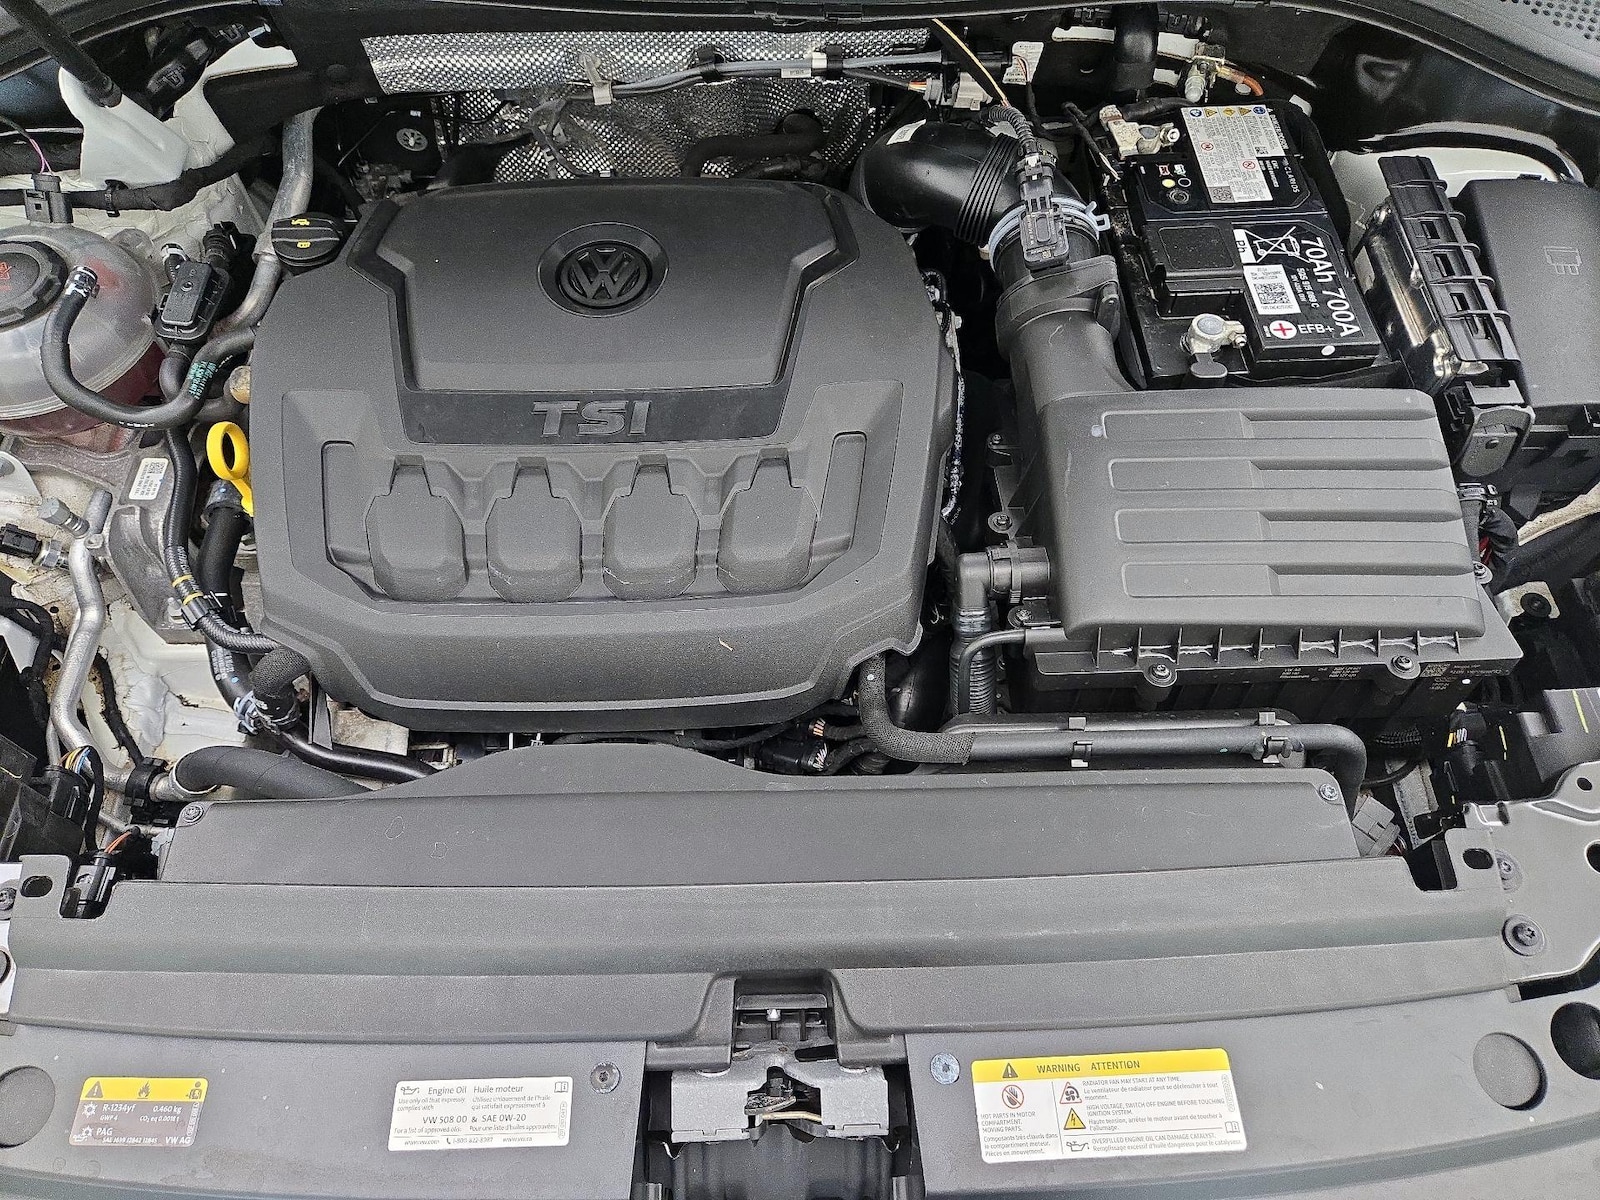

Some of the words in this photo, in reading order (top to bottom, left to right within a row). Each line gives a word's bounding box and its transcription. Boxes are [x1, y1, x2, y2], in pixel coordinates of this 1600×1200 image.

[1301, 236, 1336, 282] 70Ah
[1322, 288, 1360, 337] 700A
[530, 400, 652, 438] TSI
[1036, 1063, 1081, 1073] WARNING
[1091, 1060, 1140, 1070] ATTENTION
[428, 1086, 454, 1096] Engine
[102, 1103, 136, 1113] R-1234yf
[173, 1106, 182, 1114] kg
